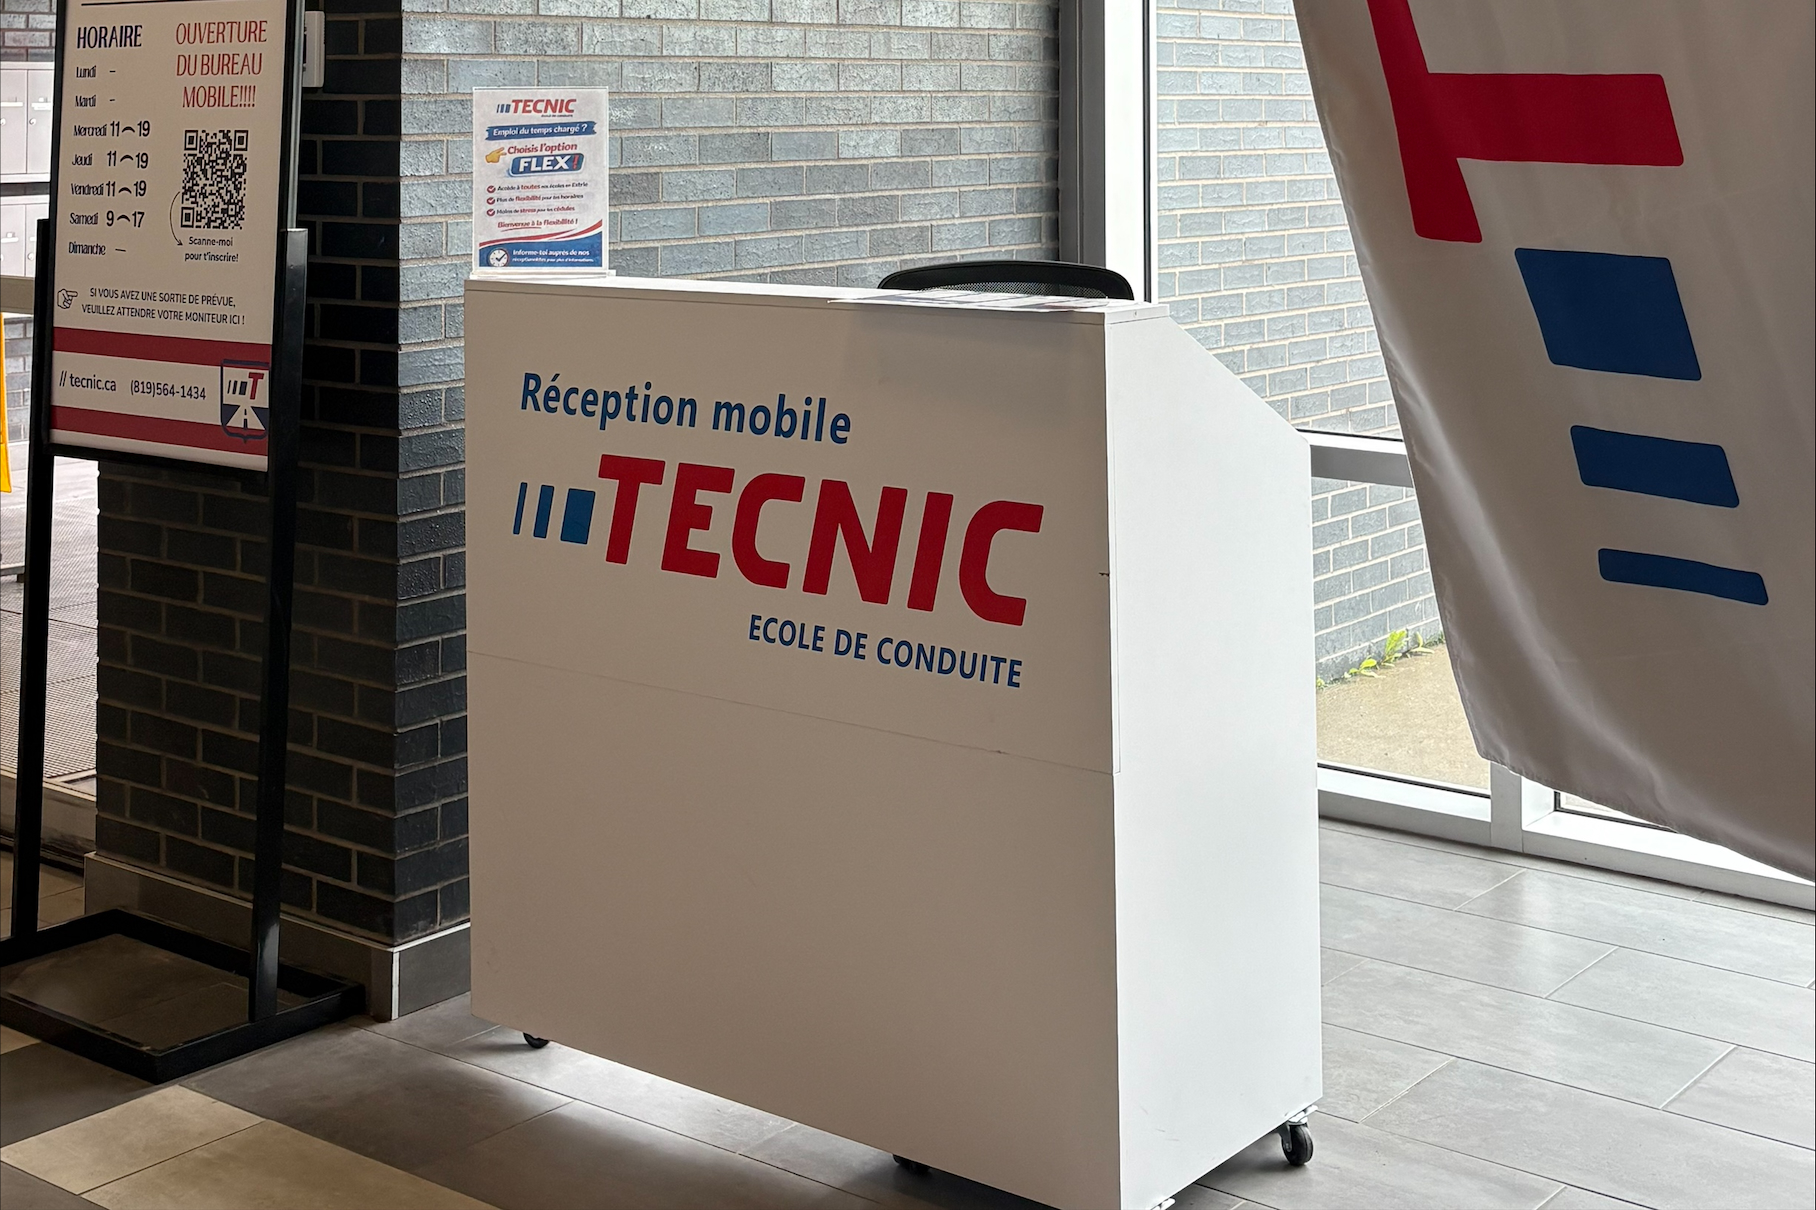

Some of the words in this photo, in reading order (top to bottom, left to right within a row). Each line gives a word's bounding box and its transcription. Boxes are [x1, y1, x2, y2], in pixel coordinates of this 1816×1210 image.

[77, 25, 142, 48] HORAIRE
[176, 20, 268, 44] OUVERTURE
[76, 65, 96, 78] Lundi
[177, 54, 197, 76] DU
[201, 53, 262, 76] BUREAU
[75, 94, 96, 107] Mardi
[183, 85, 256, 108] MOBILE!!!!
[512, 99, 576, 114] TECNIC
[74, 124, 107, 137] Mercredi
[110, 121, 120, 137] 11
[137, 120, 150, 137] 19
[531, 126, 552, 135] temps
[554, 124, 579, 134] chargé
[508, 144, 538, 154] Choisis
[540, 142, 577, 154] l'option
[72, 153, 92, 166] Jeudi
[107, 150, 116, 166] 11
[136, 153, 148, 169] 19
[71, 183, 104, 196] Vendredi
[106, 181, 115, 197] 11
[134, 180, 146, 197] 19
[70, 212, 98, 225] Samedi
[106, 210, 114, 226] 9
[132, 211, 145, 228] 17
[68, 241, 106, 255] Dimanche
[189, 236, 233, 246] Scanne-moi
[185, 253, 201, 262] pour
[204, 252, 238, 262] t'inscrire!
[90, 288, 96, 297] SI
[98, 288, 119, 299] VOUS
[121, 290, 140, 300] AVEZ
[141, 291, 157, 301] UNE
[159, 292, 186, 304] SORTIE
[189, 294, 199, 304] DE
[202, 293, 236, 308] PRÉVUE,
[82, 304, 115, 315] VEUILLEZ
[117, 307, 155, 318] ATTENDRE
[157, 310, 183, 321] VOTRE
[185, 312, 227, 324] MONITEUR
[230, 314, 240, 324] ICI
[70, 373, 116, 392] tecnic.ca
[130, 380, 206, 400] (819)564-1434
[248, 372, 264, 400] T
[520, 373, 698, 431] Réception
[712, 394, 852, 444] mobile
[598, 454, 1044, 626] TECNIC
[748, 614, 825, 652] ECOLE
[834, 629, 868, 660] DE
[877, 637, 1023, 688] CONDUITE
